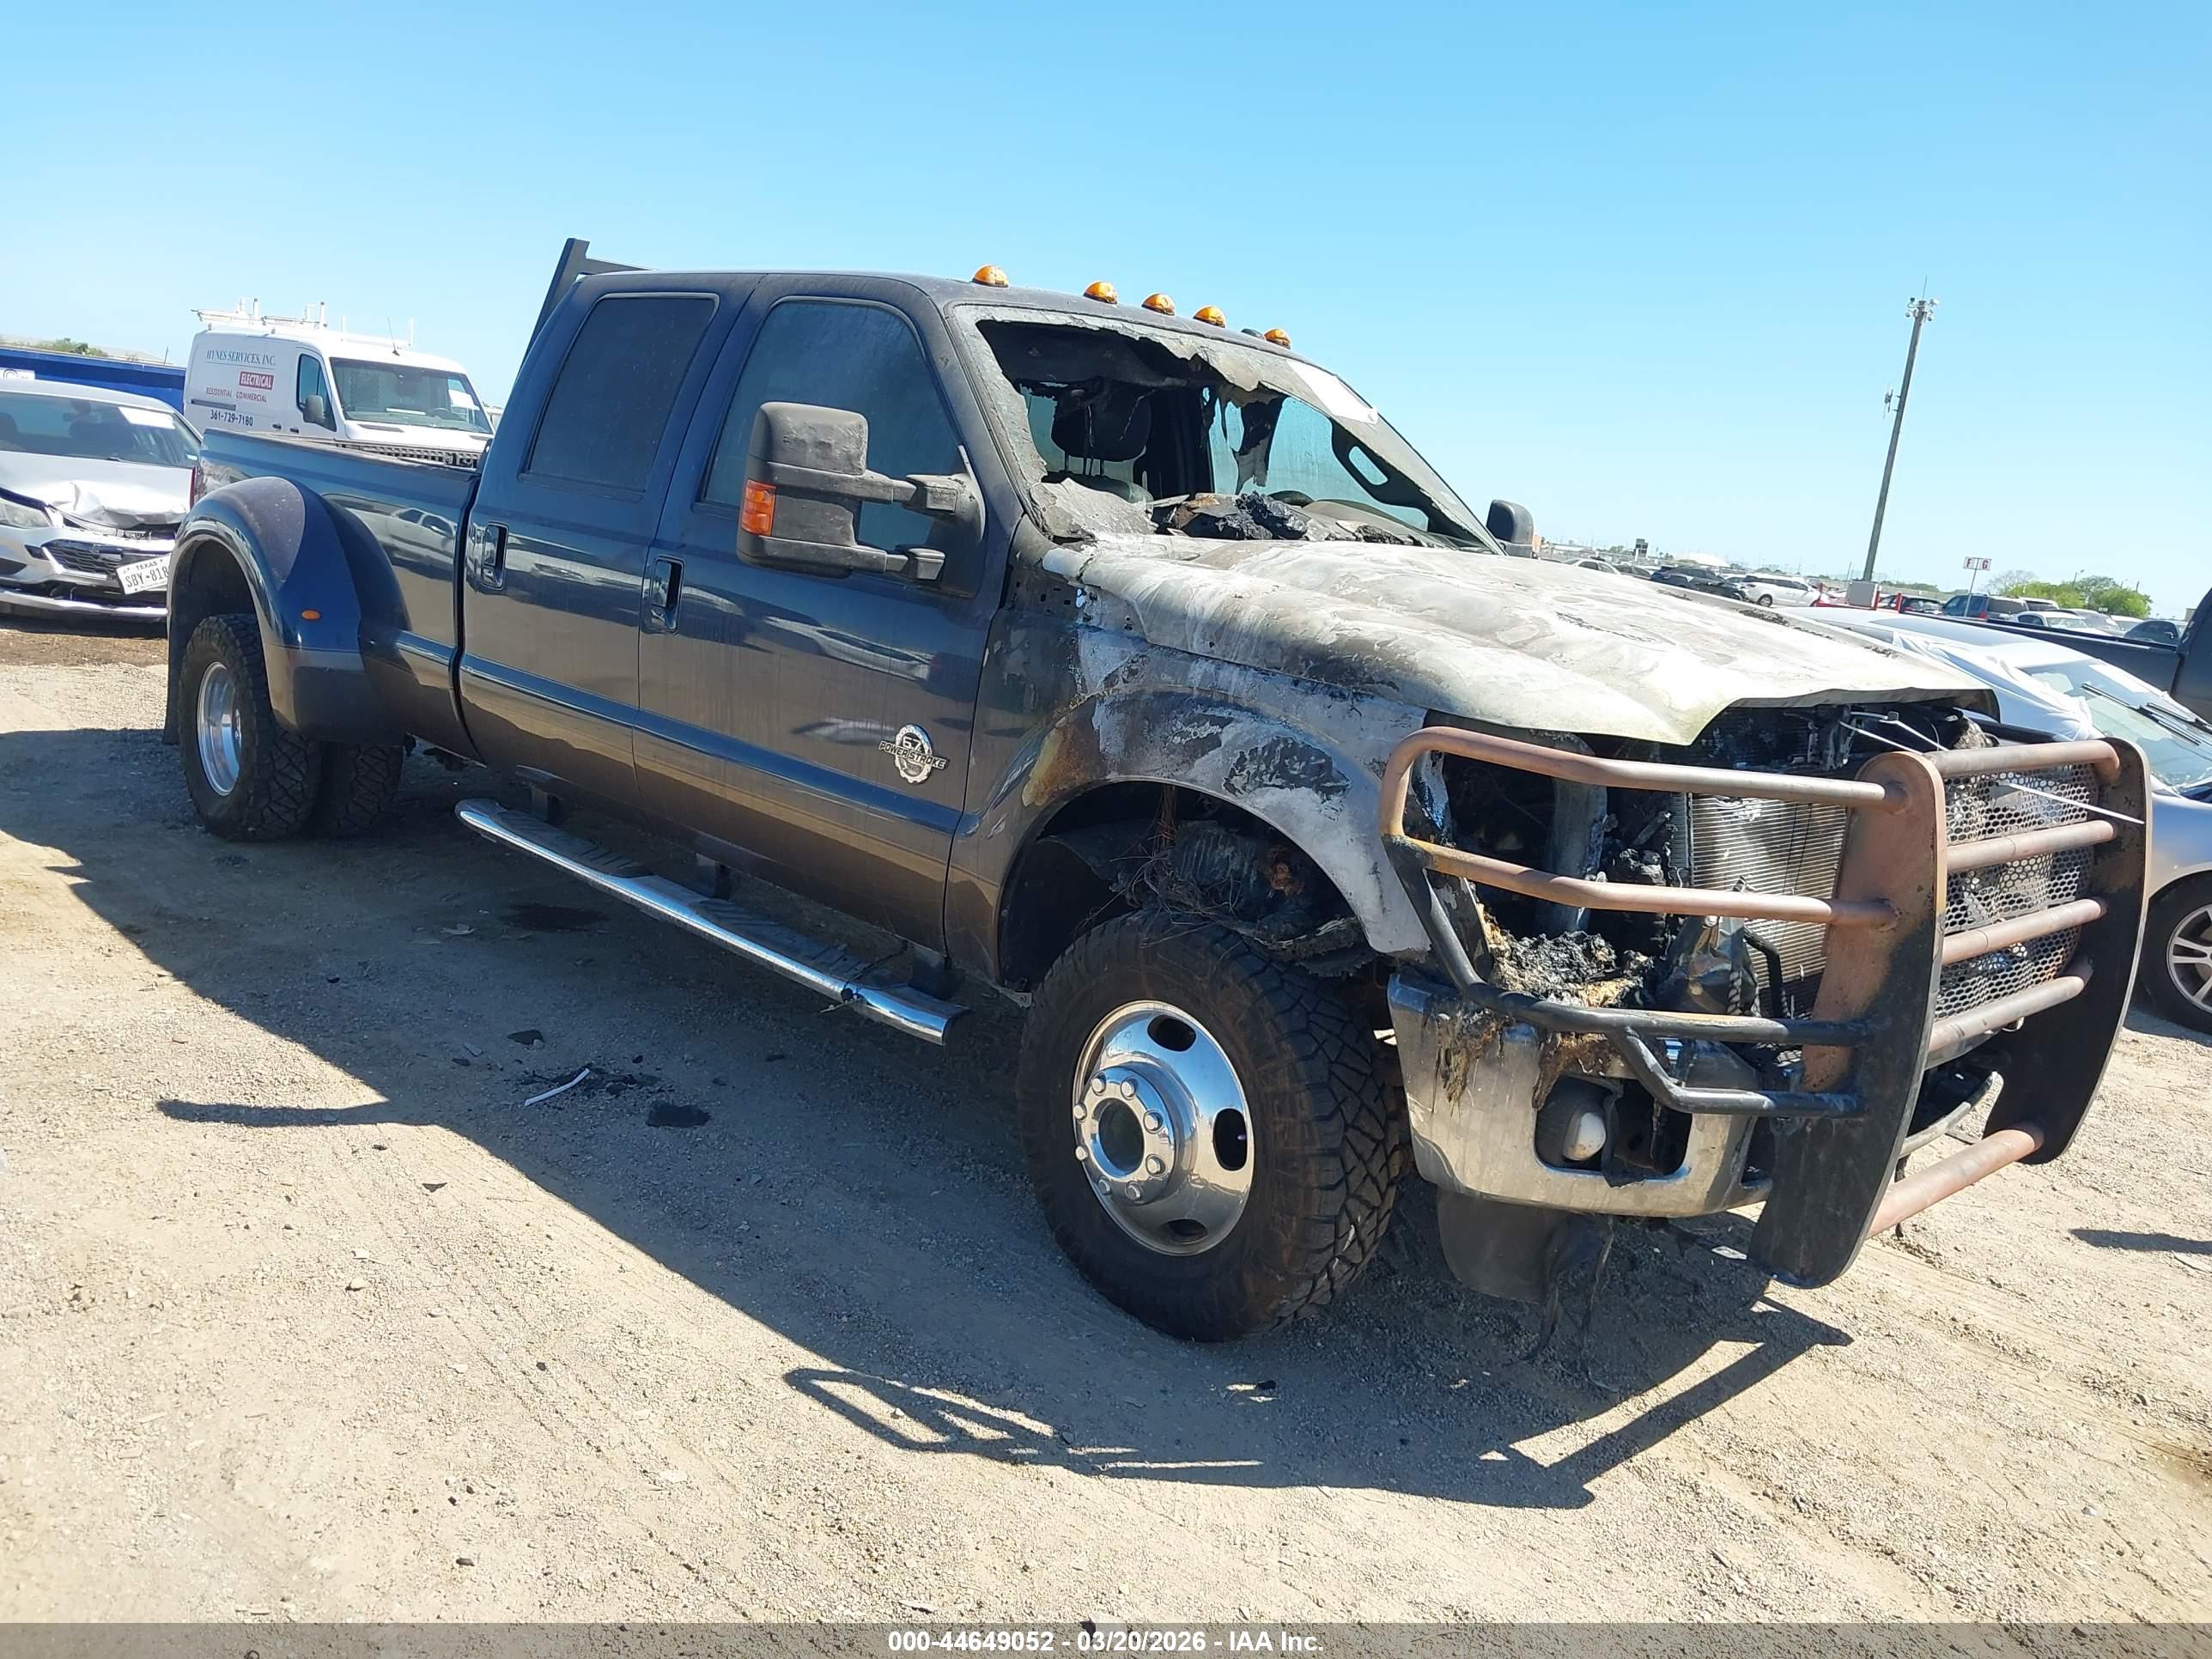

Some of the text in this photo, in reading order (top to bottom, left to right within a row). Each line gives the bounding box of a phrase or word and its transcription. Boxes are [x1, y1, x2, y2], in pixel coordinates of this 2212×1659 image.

[262, 355, 276, 366] INC.
[240, 374, 271, 387] ELECTRICAL
[206, 387, 266, 403] RESIDENTIAL COMMERCIAL
[210, 410, 253, 426] 361-729-7180
[136, 561, 157, 570] TEXAS
[1966, 558, 1989, 569] F G
